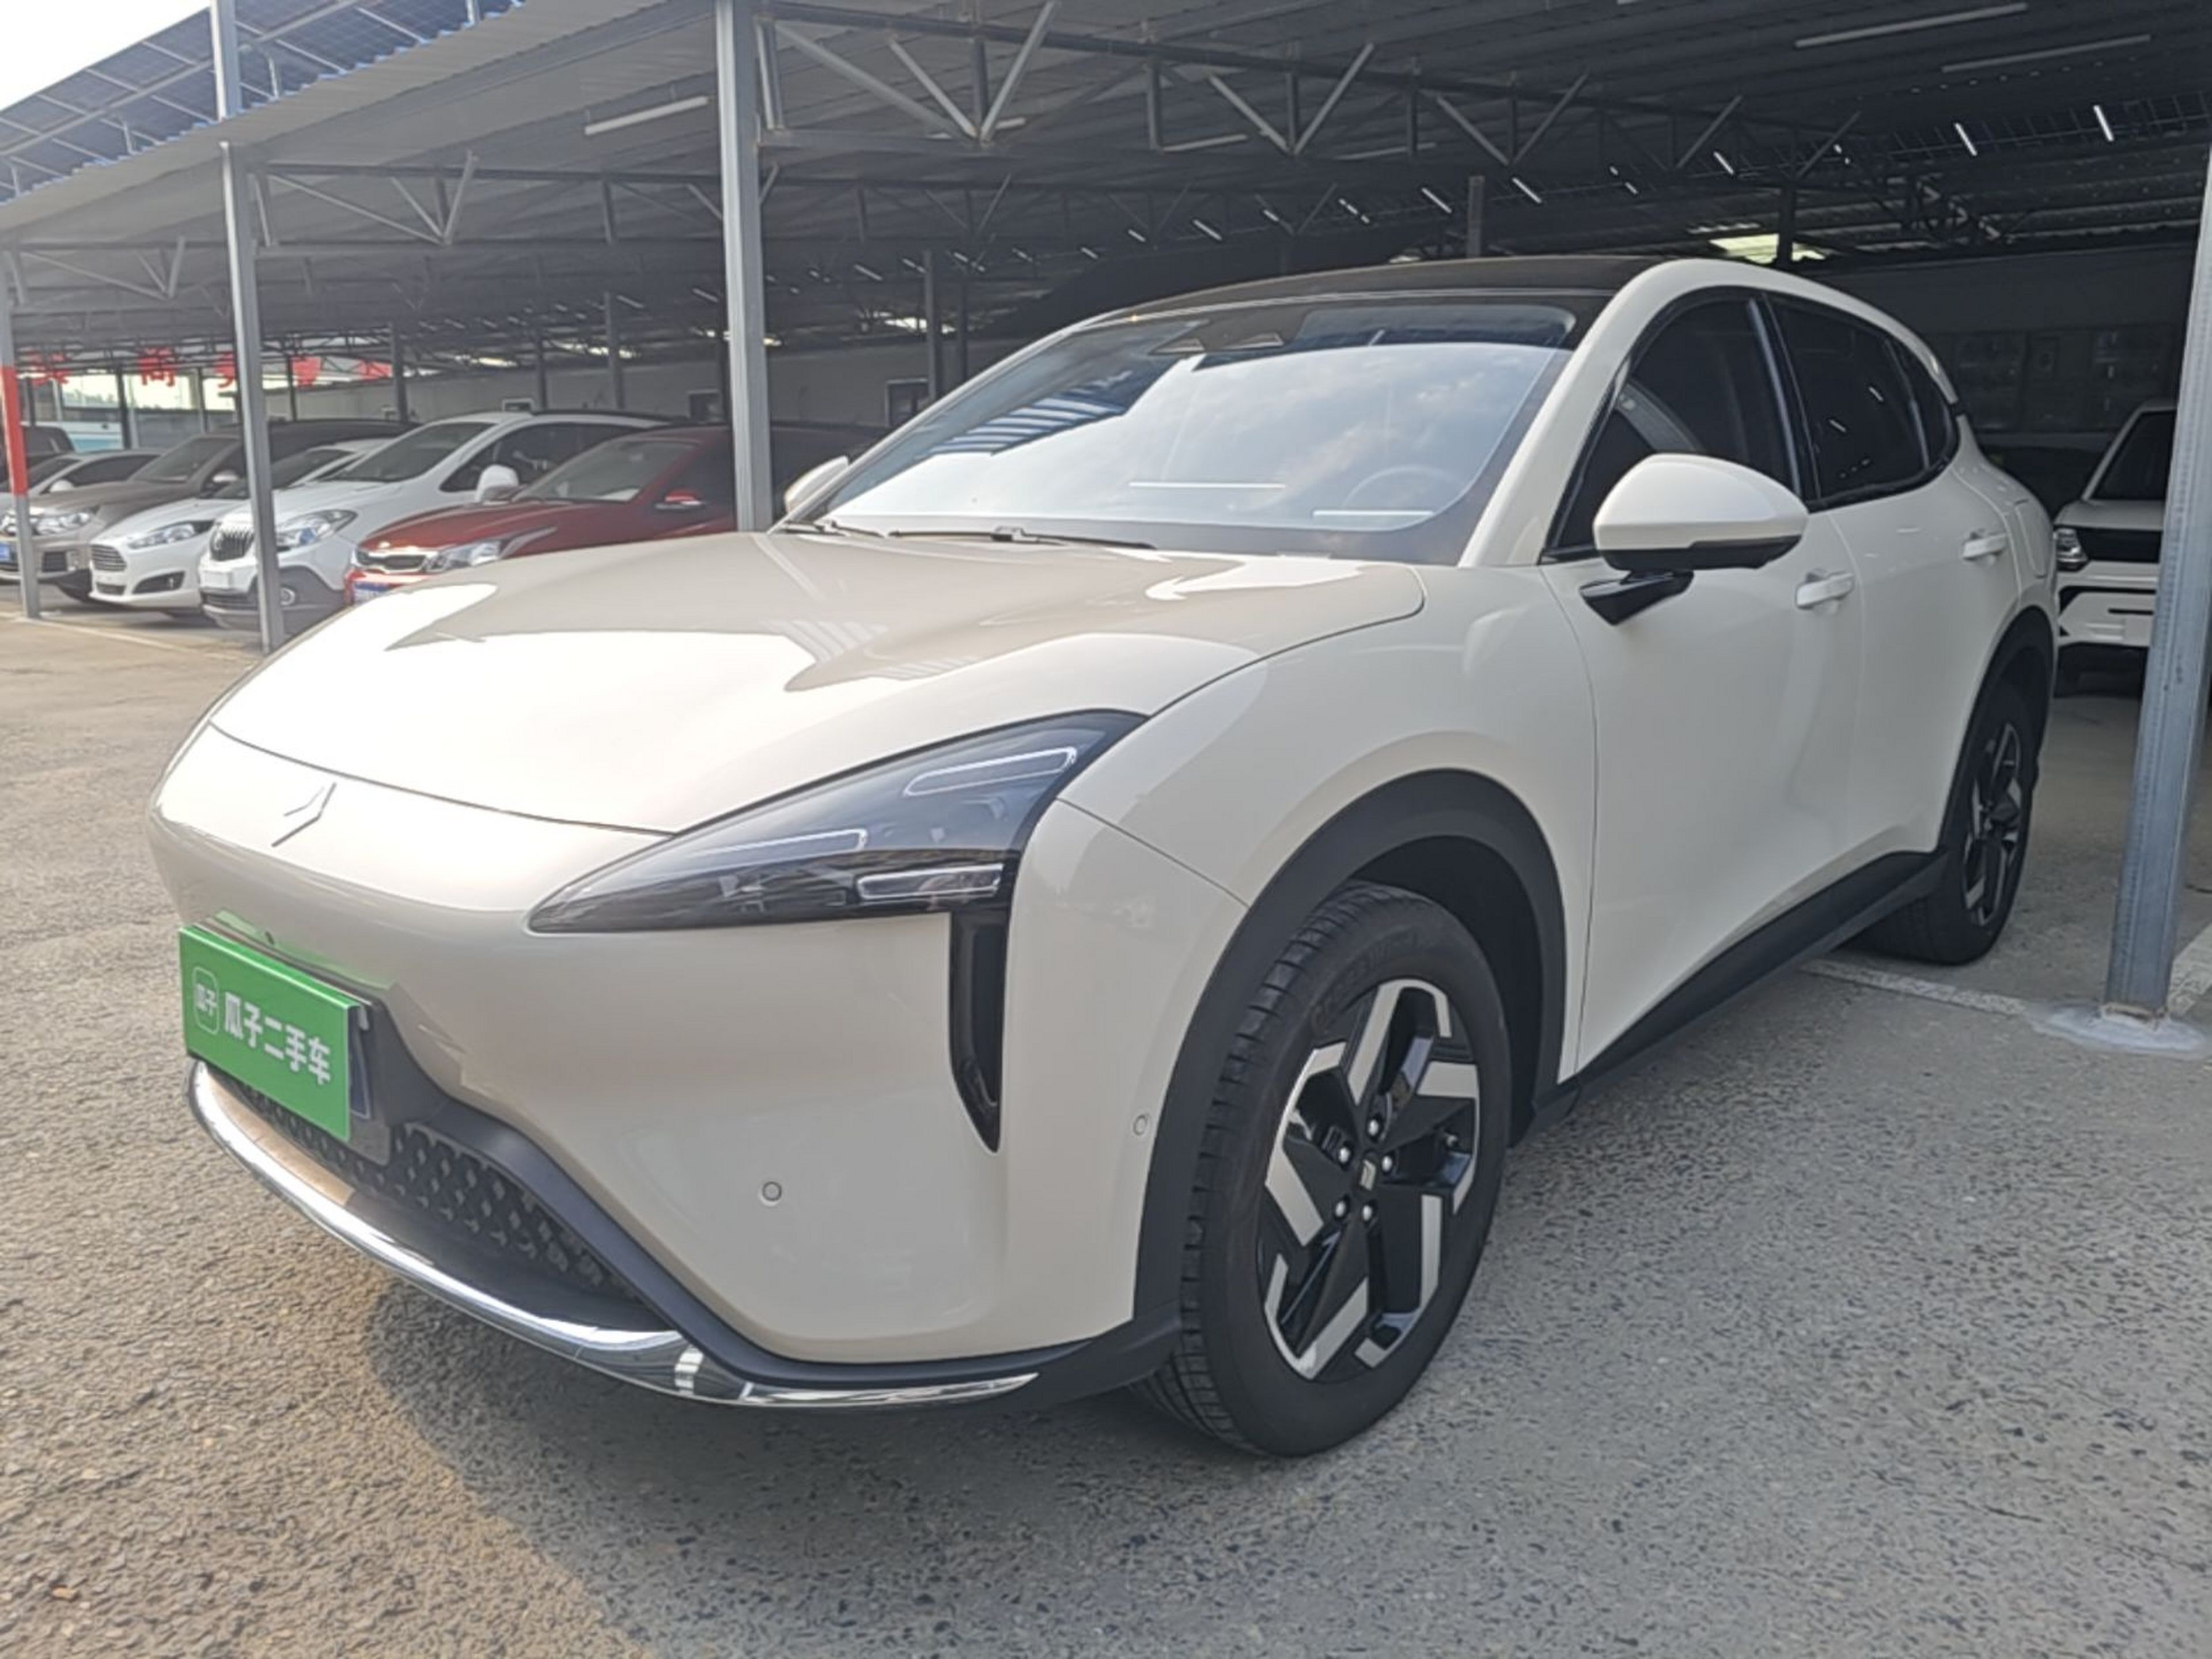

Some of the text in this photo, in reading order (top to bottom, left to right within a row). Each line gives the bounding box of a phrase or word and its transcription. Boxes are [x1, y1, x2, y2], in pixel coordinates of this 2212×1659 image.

[225, 991, 331, 1085] 瓜子二手车
